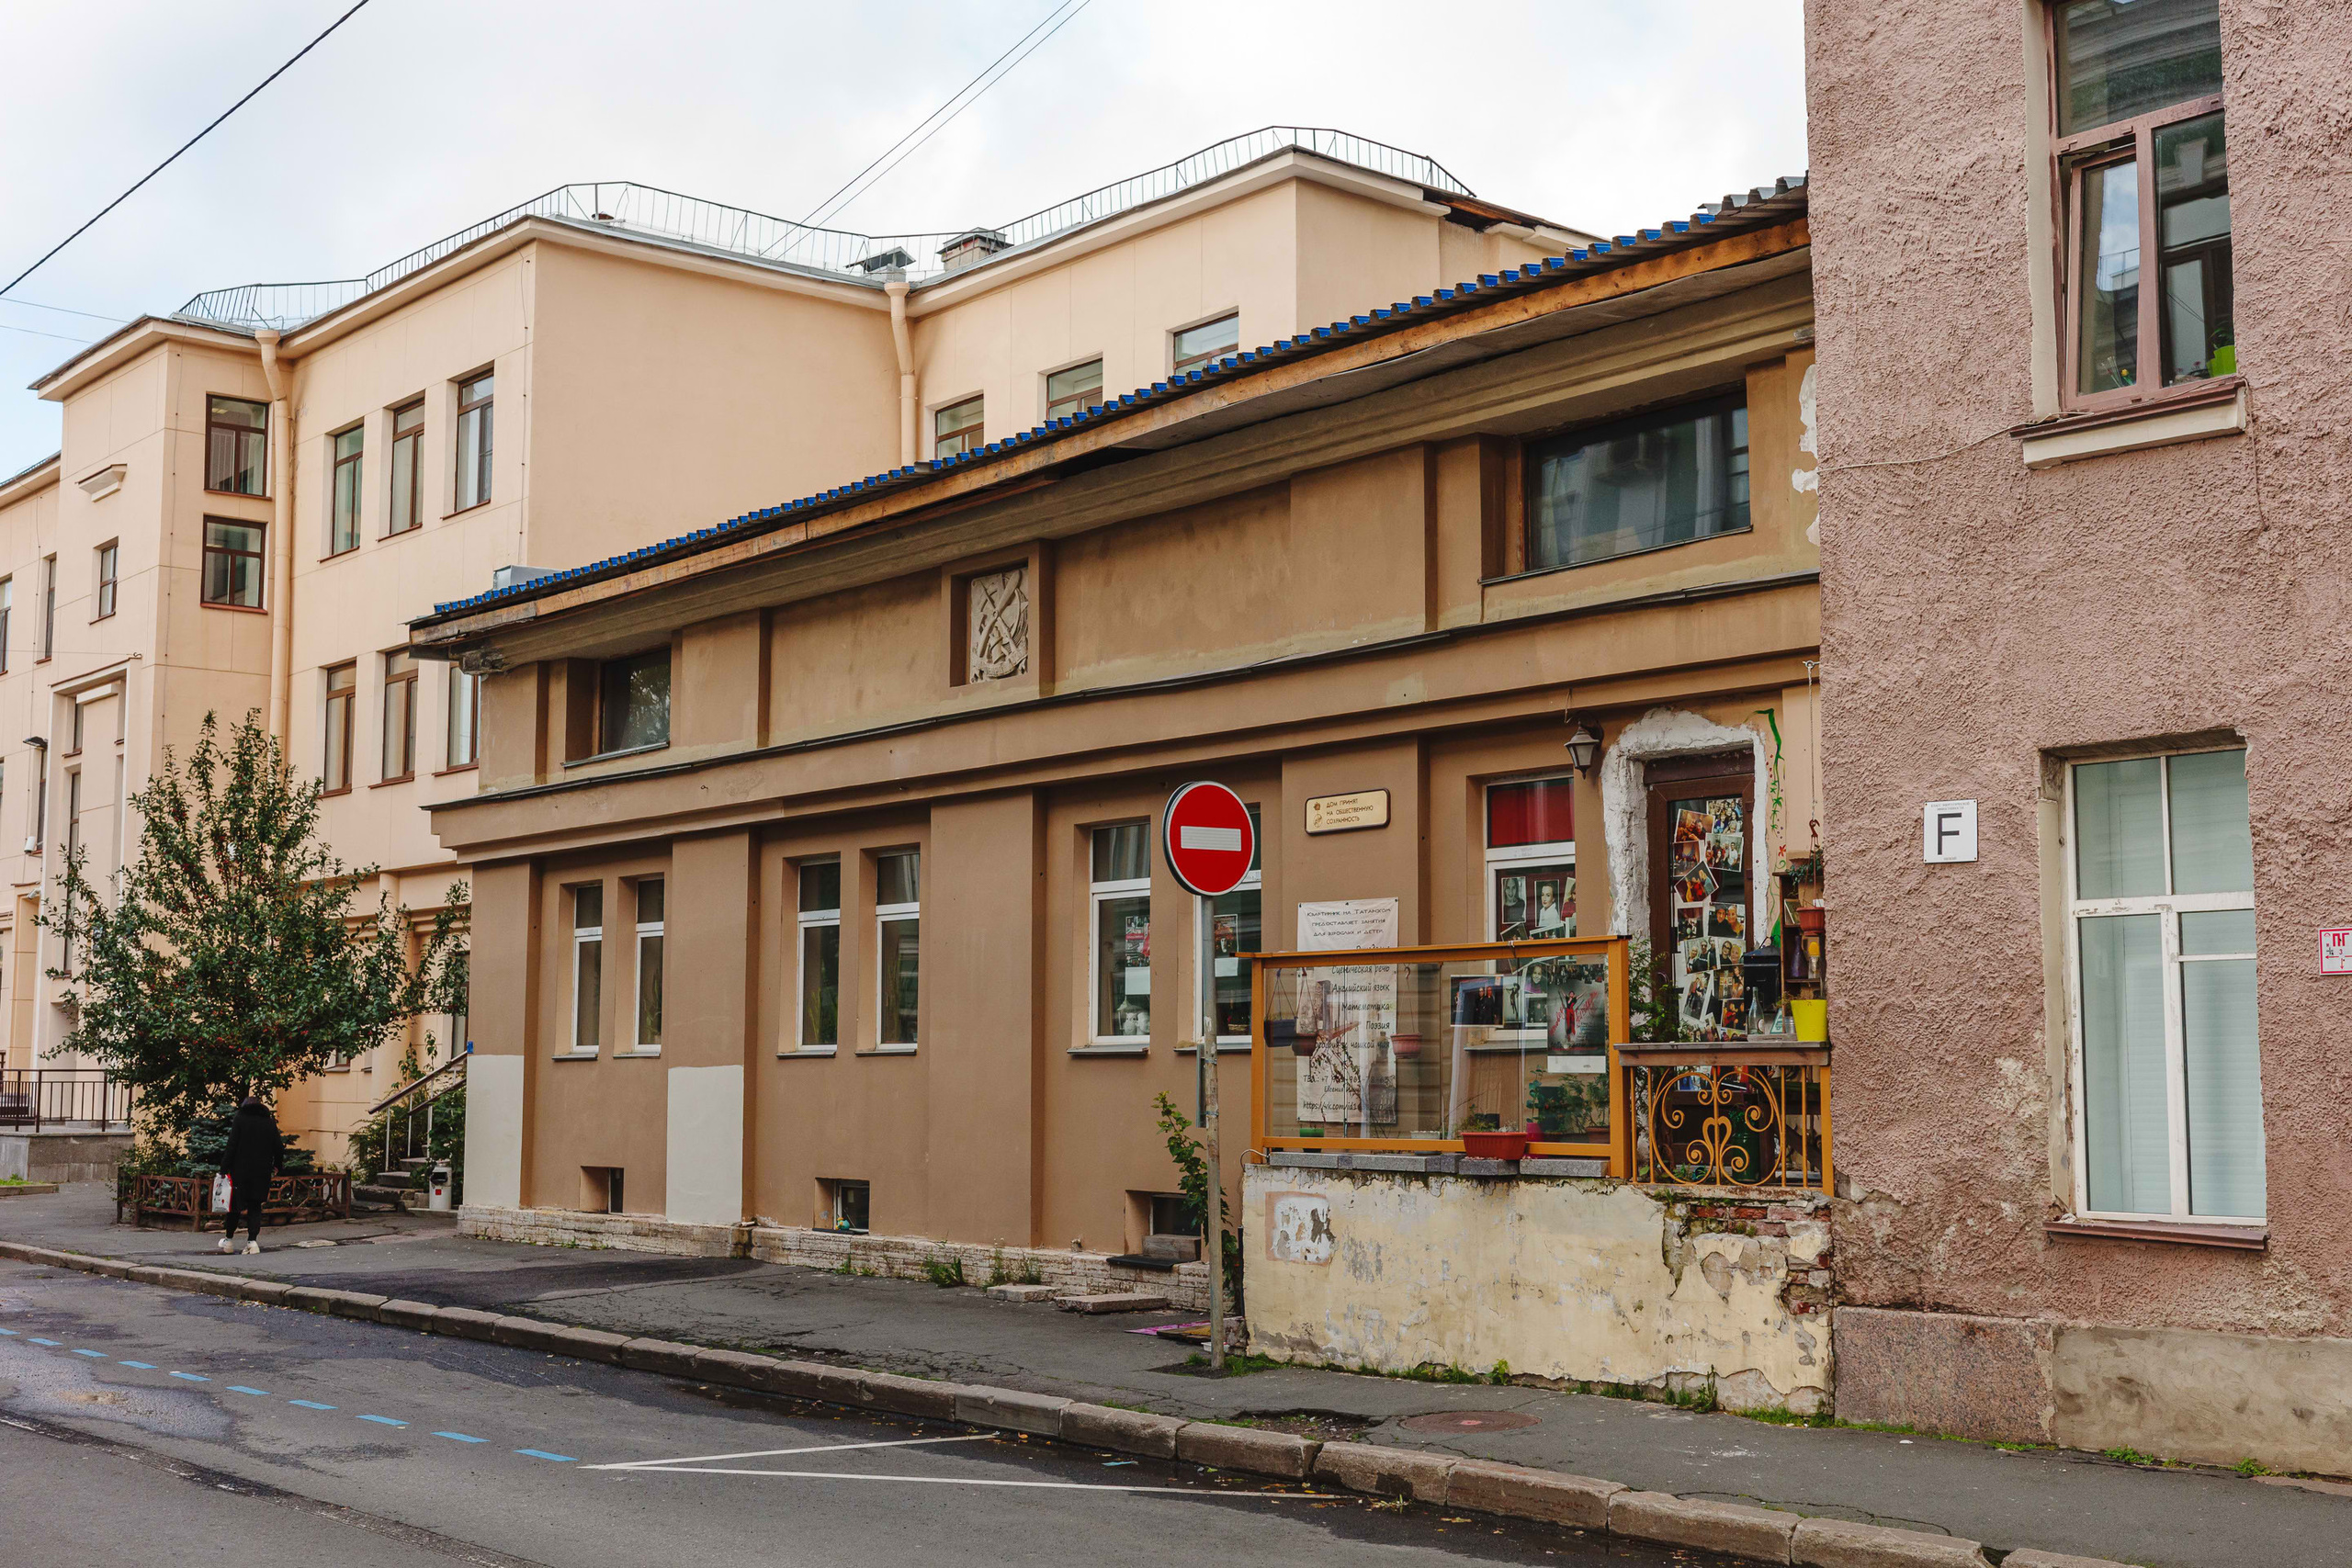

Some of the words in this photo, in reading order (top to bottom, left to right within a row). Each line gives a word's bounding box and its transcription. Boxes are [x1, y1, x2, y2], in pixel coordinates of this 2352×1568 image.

[1339, 798, 1359, 807] ПРИНЯТ
[1335, 805, 1374, 816] ОБЩЕСТВЕННУЮ
[1326, 816, 1361, 825] СОХРАННОСТЬ
[1938, 813, 1962, 855] F
[2333, 932, 2349, 946] ПГ
[1373, 984, 1390, 992] язык
[1365, 1021, 1390, 1030] Поэзия
